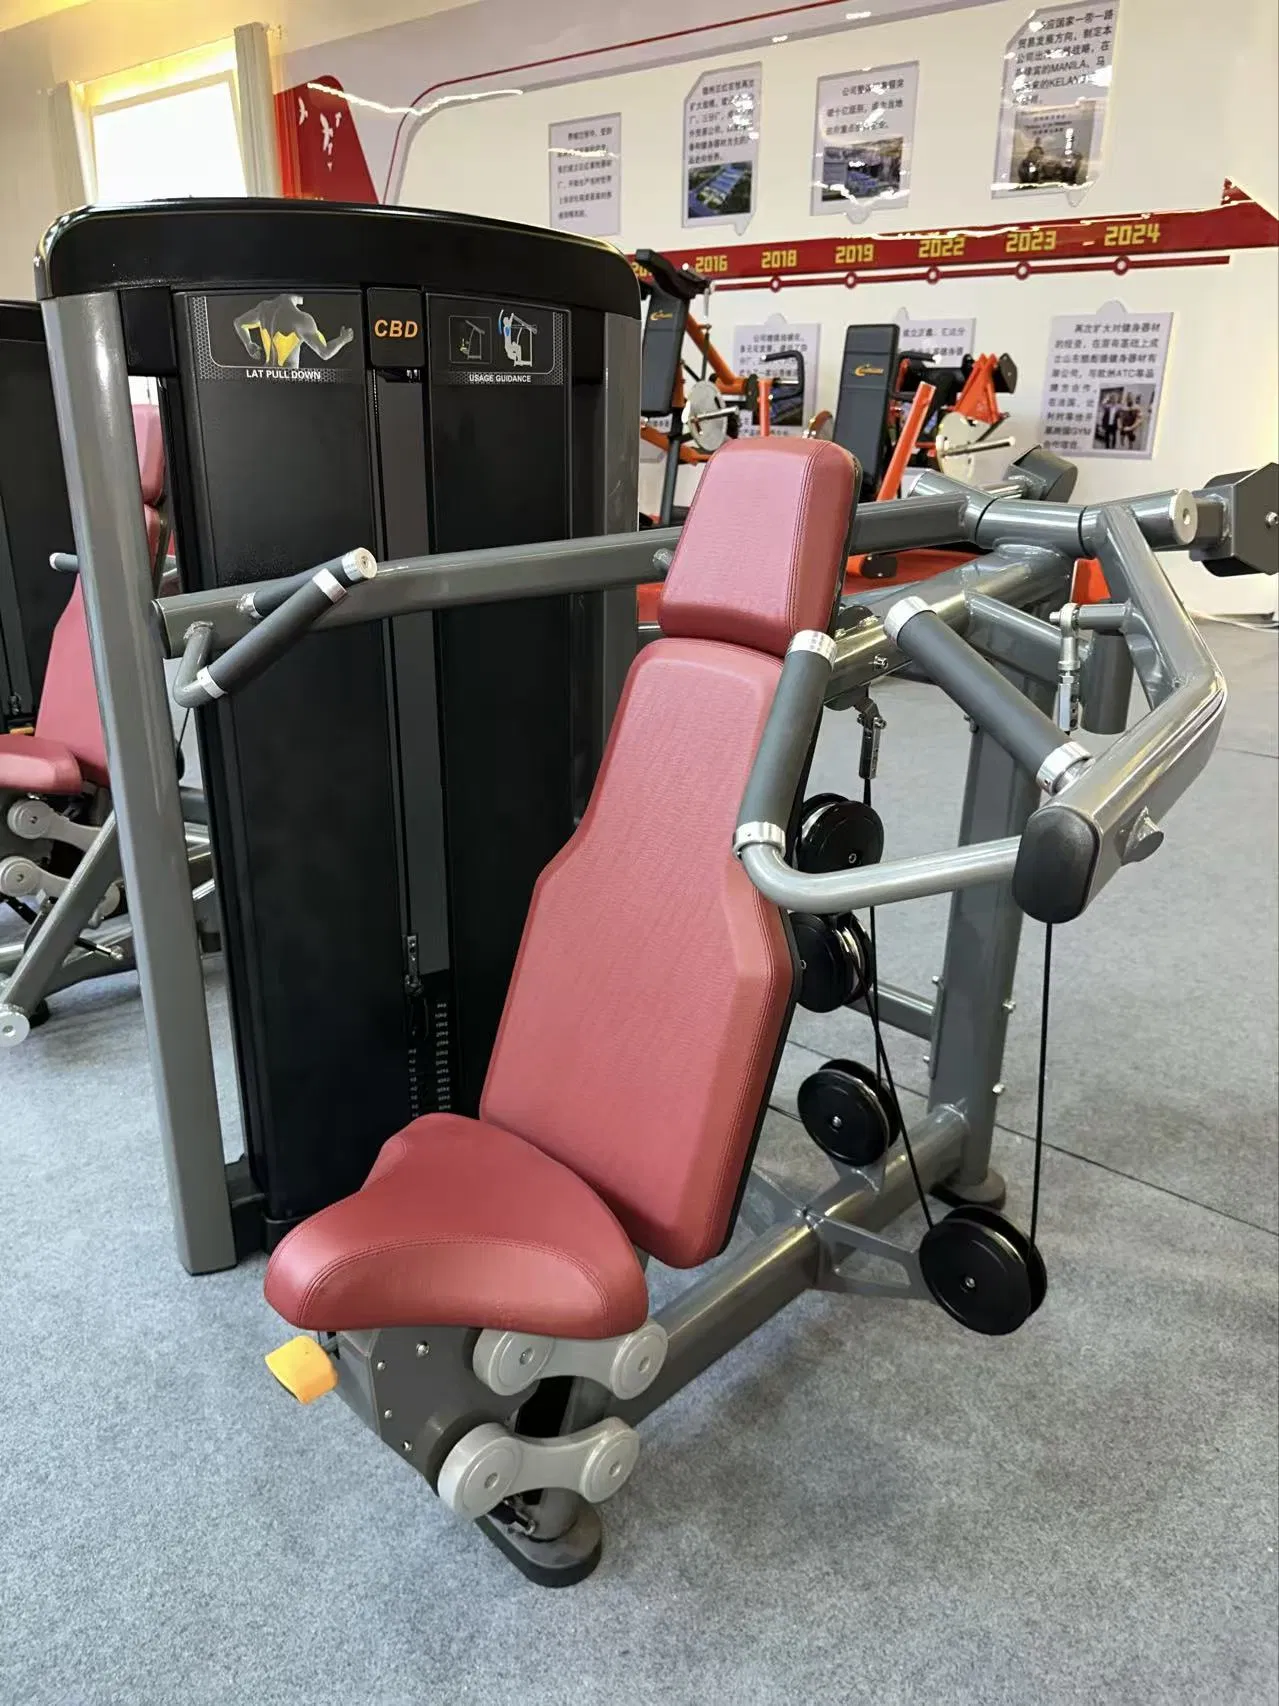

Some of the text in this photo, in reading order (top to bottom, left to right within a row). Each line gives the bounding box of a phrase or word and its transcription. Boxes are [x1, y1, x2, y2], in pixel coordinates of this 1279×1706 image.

[1006, 230, 1057, 253] 2023
[1104, 223, 1161, 247] 2024
[835, 244, 874, 264] 2019
[918, 236, 965, 258] 2022
[695, 255, 728, 273] 2016
[761, 249, 798, 268] 2018
[374, 318, 419, 339] CBD
[246, 369, 321, 380] LAT PULL DOWN
[469, 374, 532, 383] USAGE GUIDANCE
